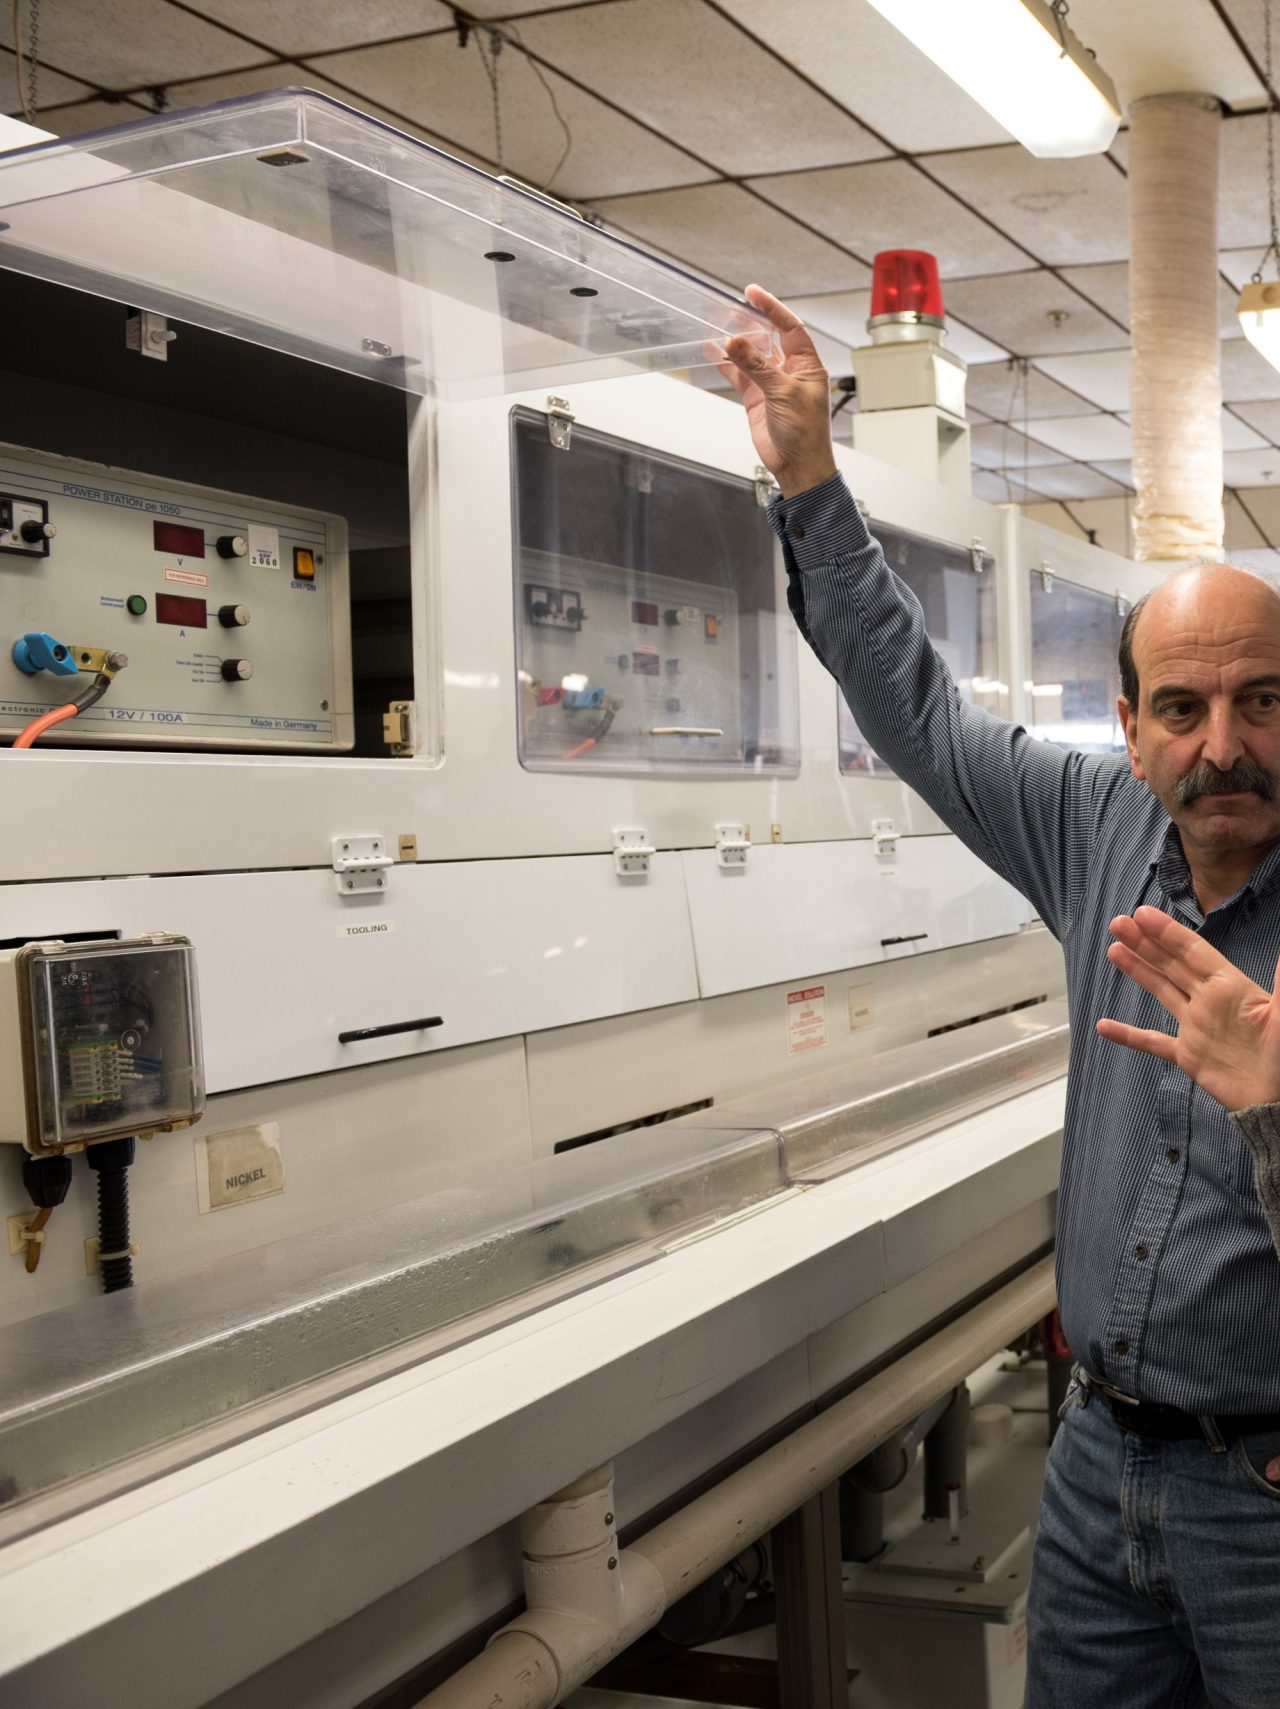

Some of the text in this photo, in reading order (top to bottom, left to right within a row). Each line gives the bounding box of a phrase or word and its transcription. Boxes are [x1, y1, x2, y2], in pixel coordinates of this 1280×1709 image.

[63, 484, 181, 515] POWER STATION pe 1050
[177, 557, 183, 566] V
[252, 556, 277, 567] 2060
[179, 629, 186, 638] A
[109, 710, 137, 720] 12V
[150, 713, 183, 722] 100A
[250, 718, 317, 731] Made in Germany
[346, 924, 388, 935] TOOLING
[226, 1168, 267, 1190] NICKEL
